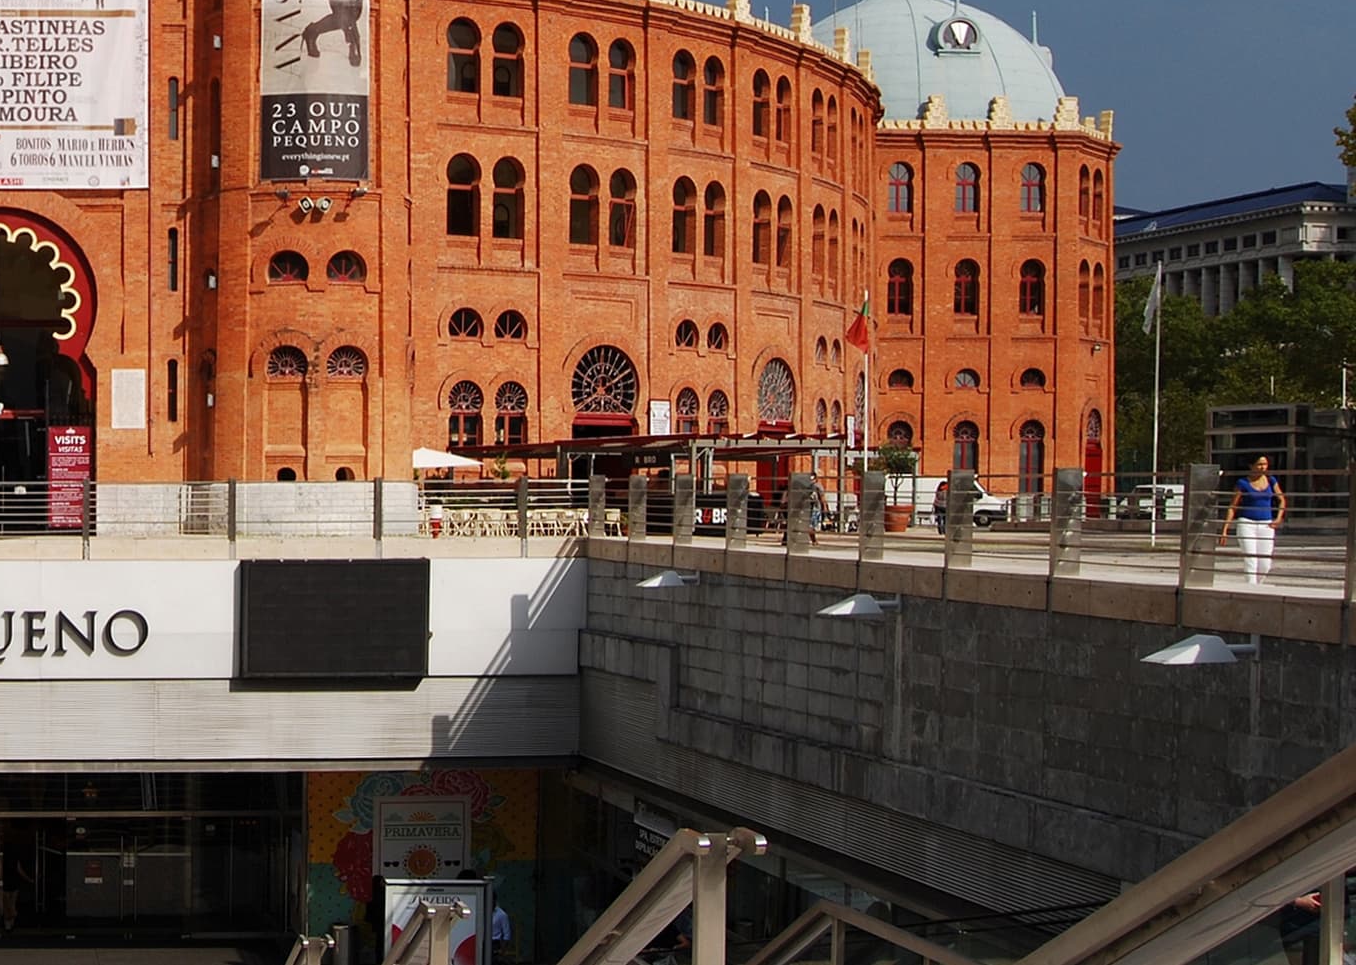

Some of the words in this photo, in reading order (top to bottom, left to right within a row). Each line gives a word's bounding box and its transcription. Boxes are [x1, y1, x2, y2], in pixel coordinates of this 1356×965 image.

[11, 72, 83, 87] FILIPE
[1, 89, 67, 105] PINTO
[272, 103, 297, 118] 23
[309, 101, 360, 118] OUT
[272, 119, 360, 135] CAMPO
[16, 138, 52, 150] BONITOS
[273, 135, 359, 148] PEQUENO
[10, 152, 17, 166] 6
[19, 153, 49, 166] TOIROS
[49, 152, 56, 166] 6
[59, 153, 96, 167] MANUEL
[99, 153, 133, 167] VINHAS
[54, 435, 86, 445] VISITS
[384, 826, 460, 837] PRIMAVERA
